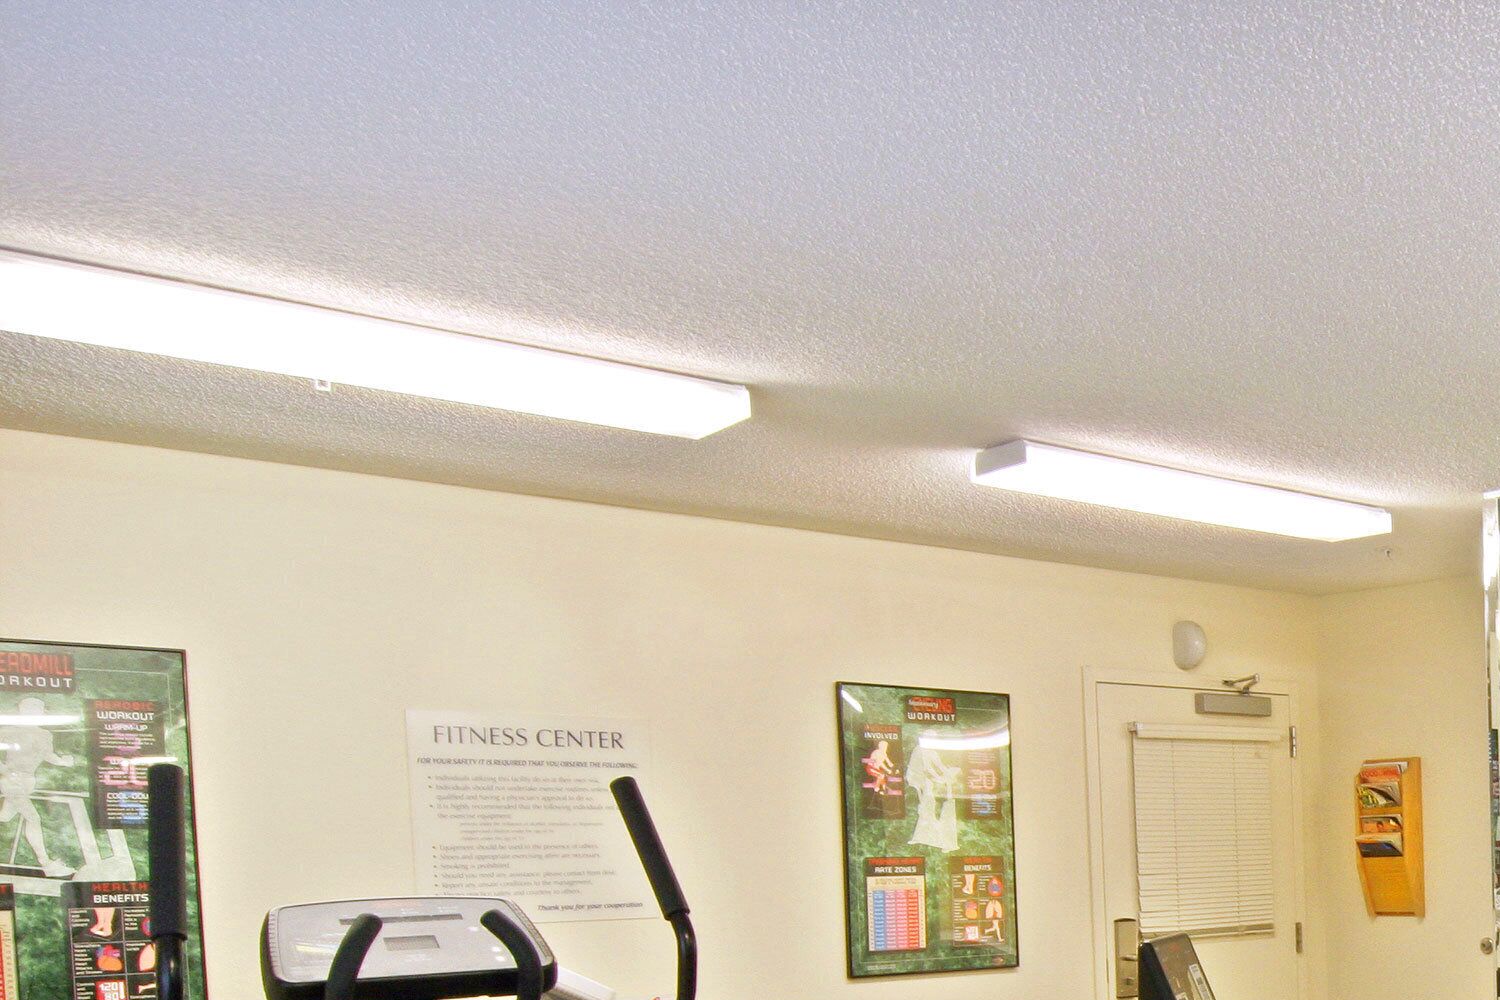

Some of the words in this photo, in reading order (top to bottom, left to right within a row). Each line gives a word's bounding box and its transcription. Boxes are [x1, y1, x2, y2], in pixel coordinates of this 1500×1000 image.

[96, 710, 155, 721] WORKOUT
[907, 712, 956, 722] WORKOUT
[433, 725, 528, 747] FITNESS
[535, 728, 625, 750] CENTER
[894, 865, 917, 873] ZONES
[93, 893, 149, 903] BENEFITS
